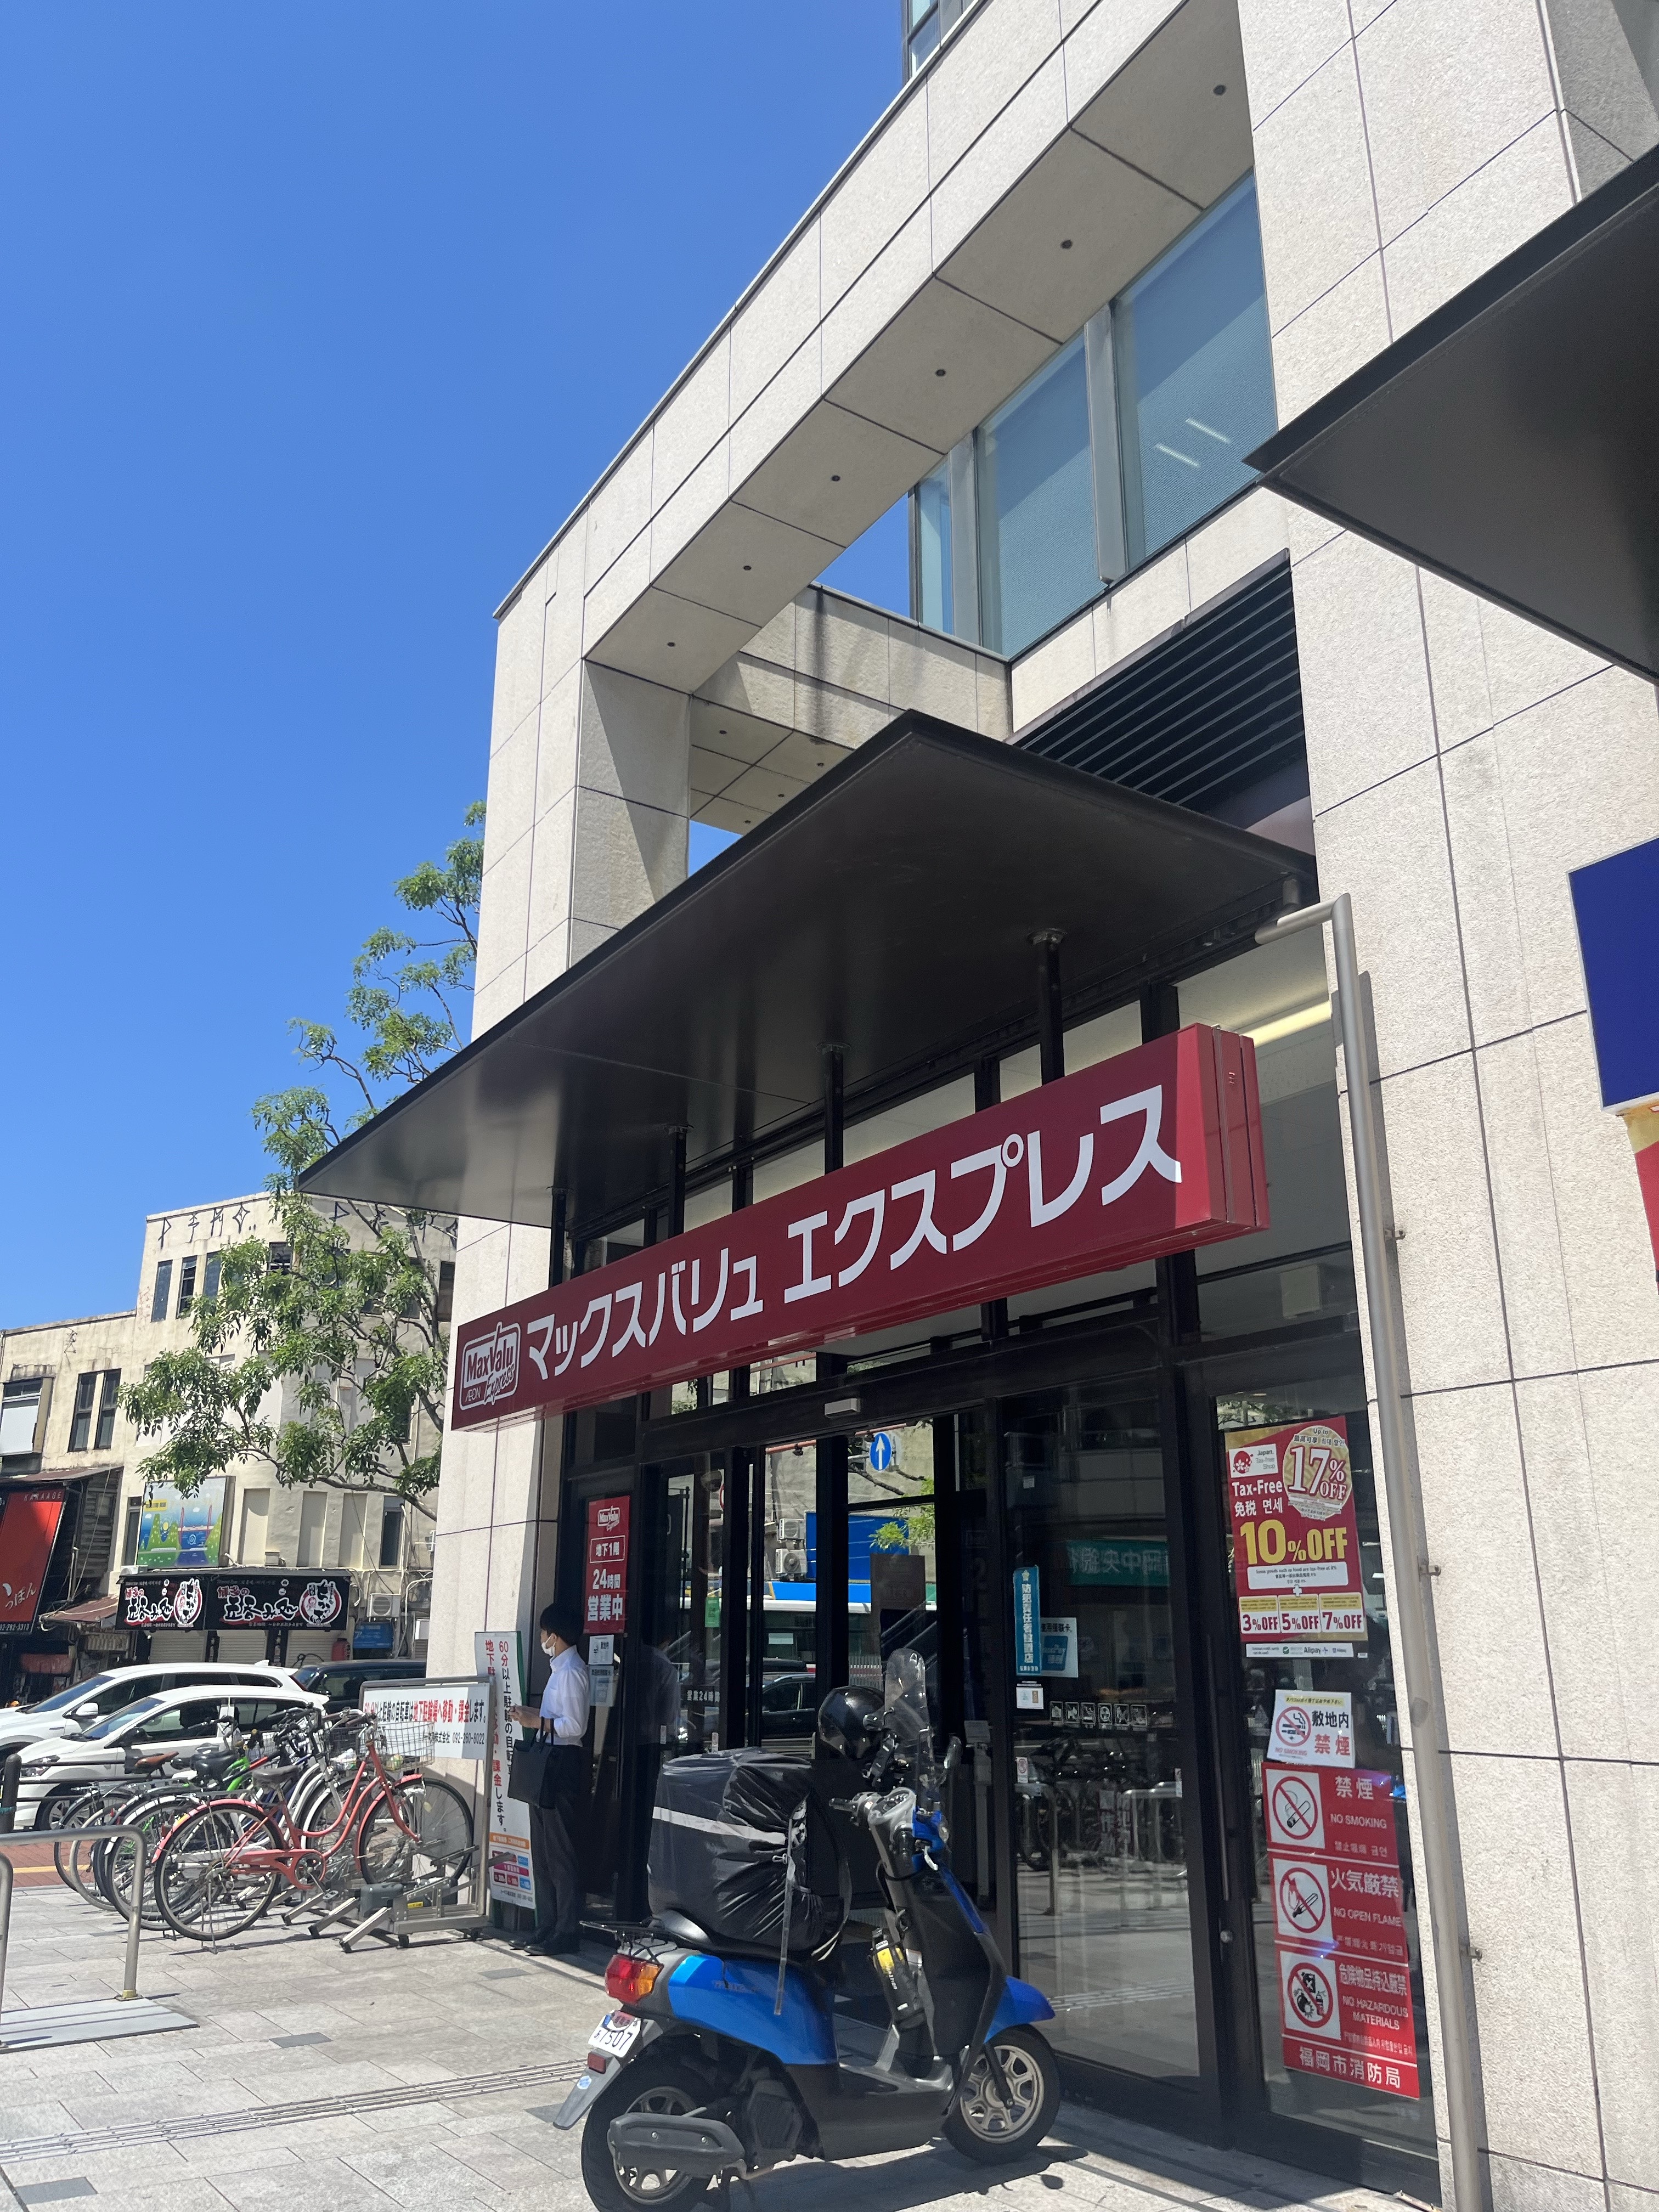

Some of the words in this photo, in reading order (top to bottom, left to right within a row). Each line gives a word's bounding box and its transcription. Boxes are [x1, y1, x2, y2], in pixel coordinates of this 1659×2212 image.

[527, 1247, 764, 1380] マックスバリュ
[784, 1084, 1183, 1303] エクスプレス
[466, 1325, 515, 1383] MaxValu
[483, 1363, 516, 1405] Express
[1232, 1479, 1283, 1497] Tax-Free
[1319, 1481, 1347, 1500] OFF
[1262, 1497, 1283, 1514] 면세
[592, 1568, 620, 1590] 24時間
[587, 1594, 623, 1622] 営業中
[1312, 1710, 1350, 1729] 敷地内
[1283, 1747, 1308, 1756] SMOKING
[1314, 1734, 1351, 1756] 禁煙
[1335, 1775, 1374, 1801] 禁煙
[1330, 1813, 1343, 1824] NO
[1345, 1815, 1387, 1830] SMOKING
[1330, 1867, 1400, 1898] 火気厳禁
[1333, 1906, 1346, 1918] NO
[1347, 1909, 1371, 1922] OPEN
[1373, 1913, 1402, 1927] FLAME
[1339, 1963, 1407, 1996] 危険物品持込厳禁
[1342, 1995, 1355, 2006] NO
[1356, 1998, 1409, 2018] HAZARDOUS
[1353, 2011, 1400, 2030] MATERIALS
[1299, 2045, 1401, 2089] 福岡市消防局
